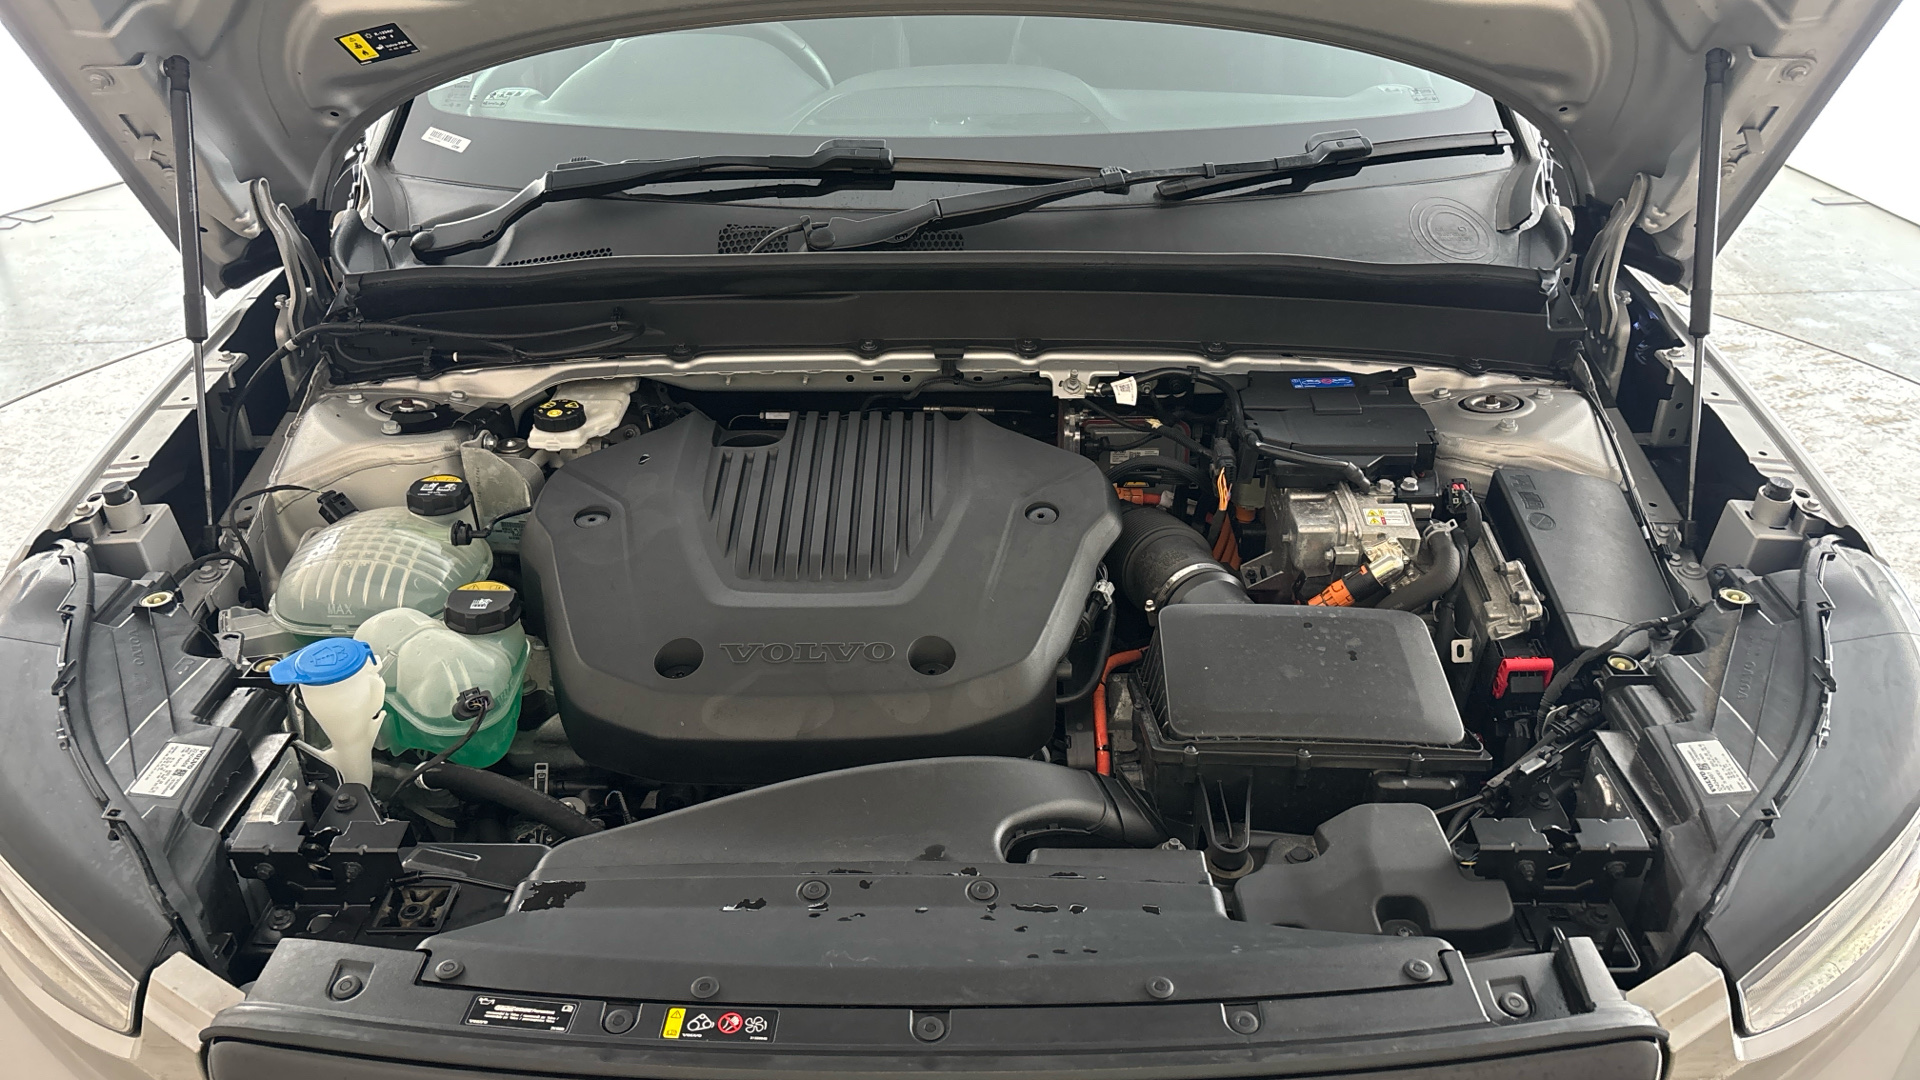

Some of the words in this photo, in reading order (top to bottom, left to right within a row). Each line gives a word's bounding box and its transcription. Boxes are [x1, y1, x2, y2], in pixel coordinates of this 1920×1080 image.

[327, 603, 353, 615] MAX
[128, 629, 145, 667] VOLVO
[719, 642, 896, 664] VOLVO
[1737, 661, 1757, 699] VOLVO
[187, 749, 206, 769] VOLVO
[1700, 770, 1717, 792] VOLVO
